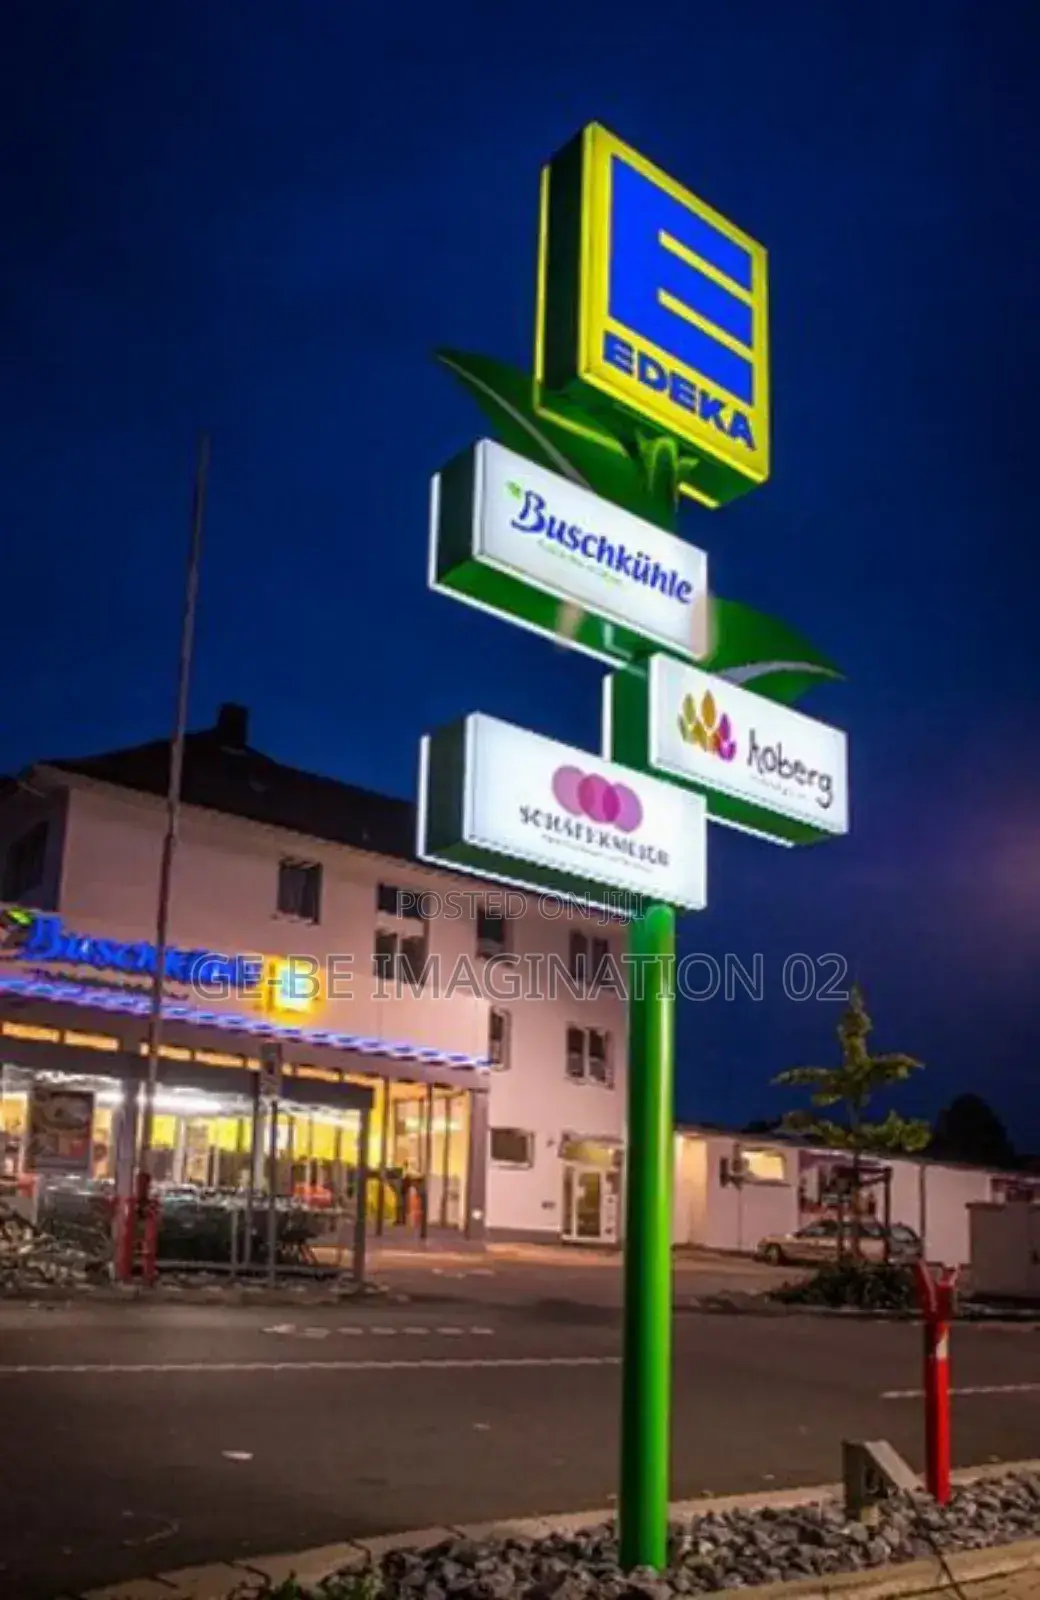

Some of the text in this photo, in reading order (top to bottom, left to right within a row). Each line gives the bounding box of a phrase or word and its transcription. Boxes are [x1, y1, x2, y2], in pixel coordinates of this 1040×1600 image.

[603, 331, 756, 451] EDEKA
[510, 490, 693, 604] Buschkühle
[747, 727, 834, 809] hoberg
